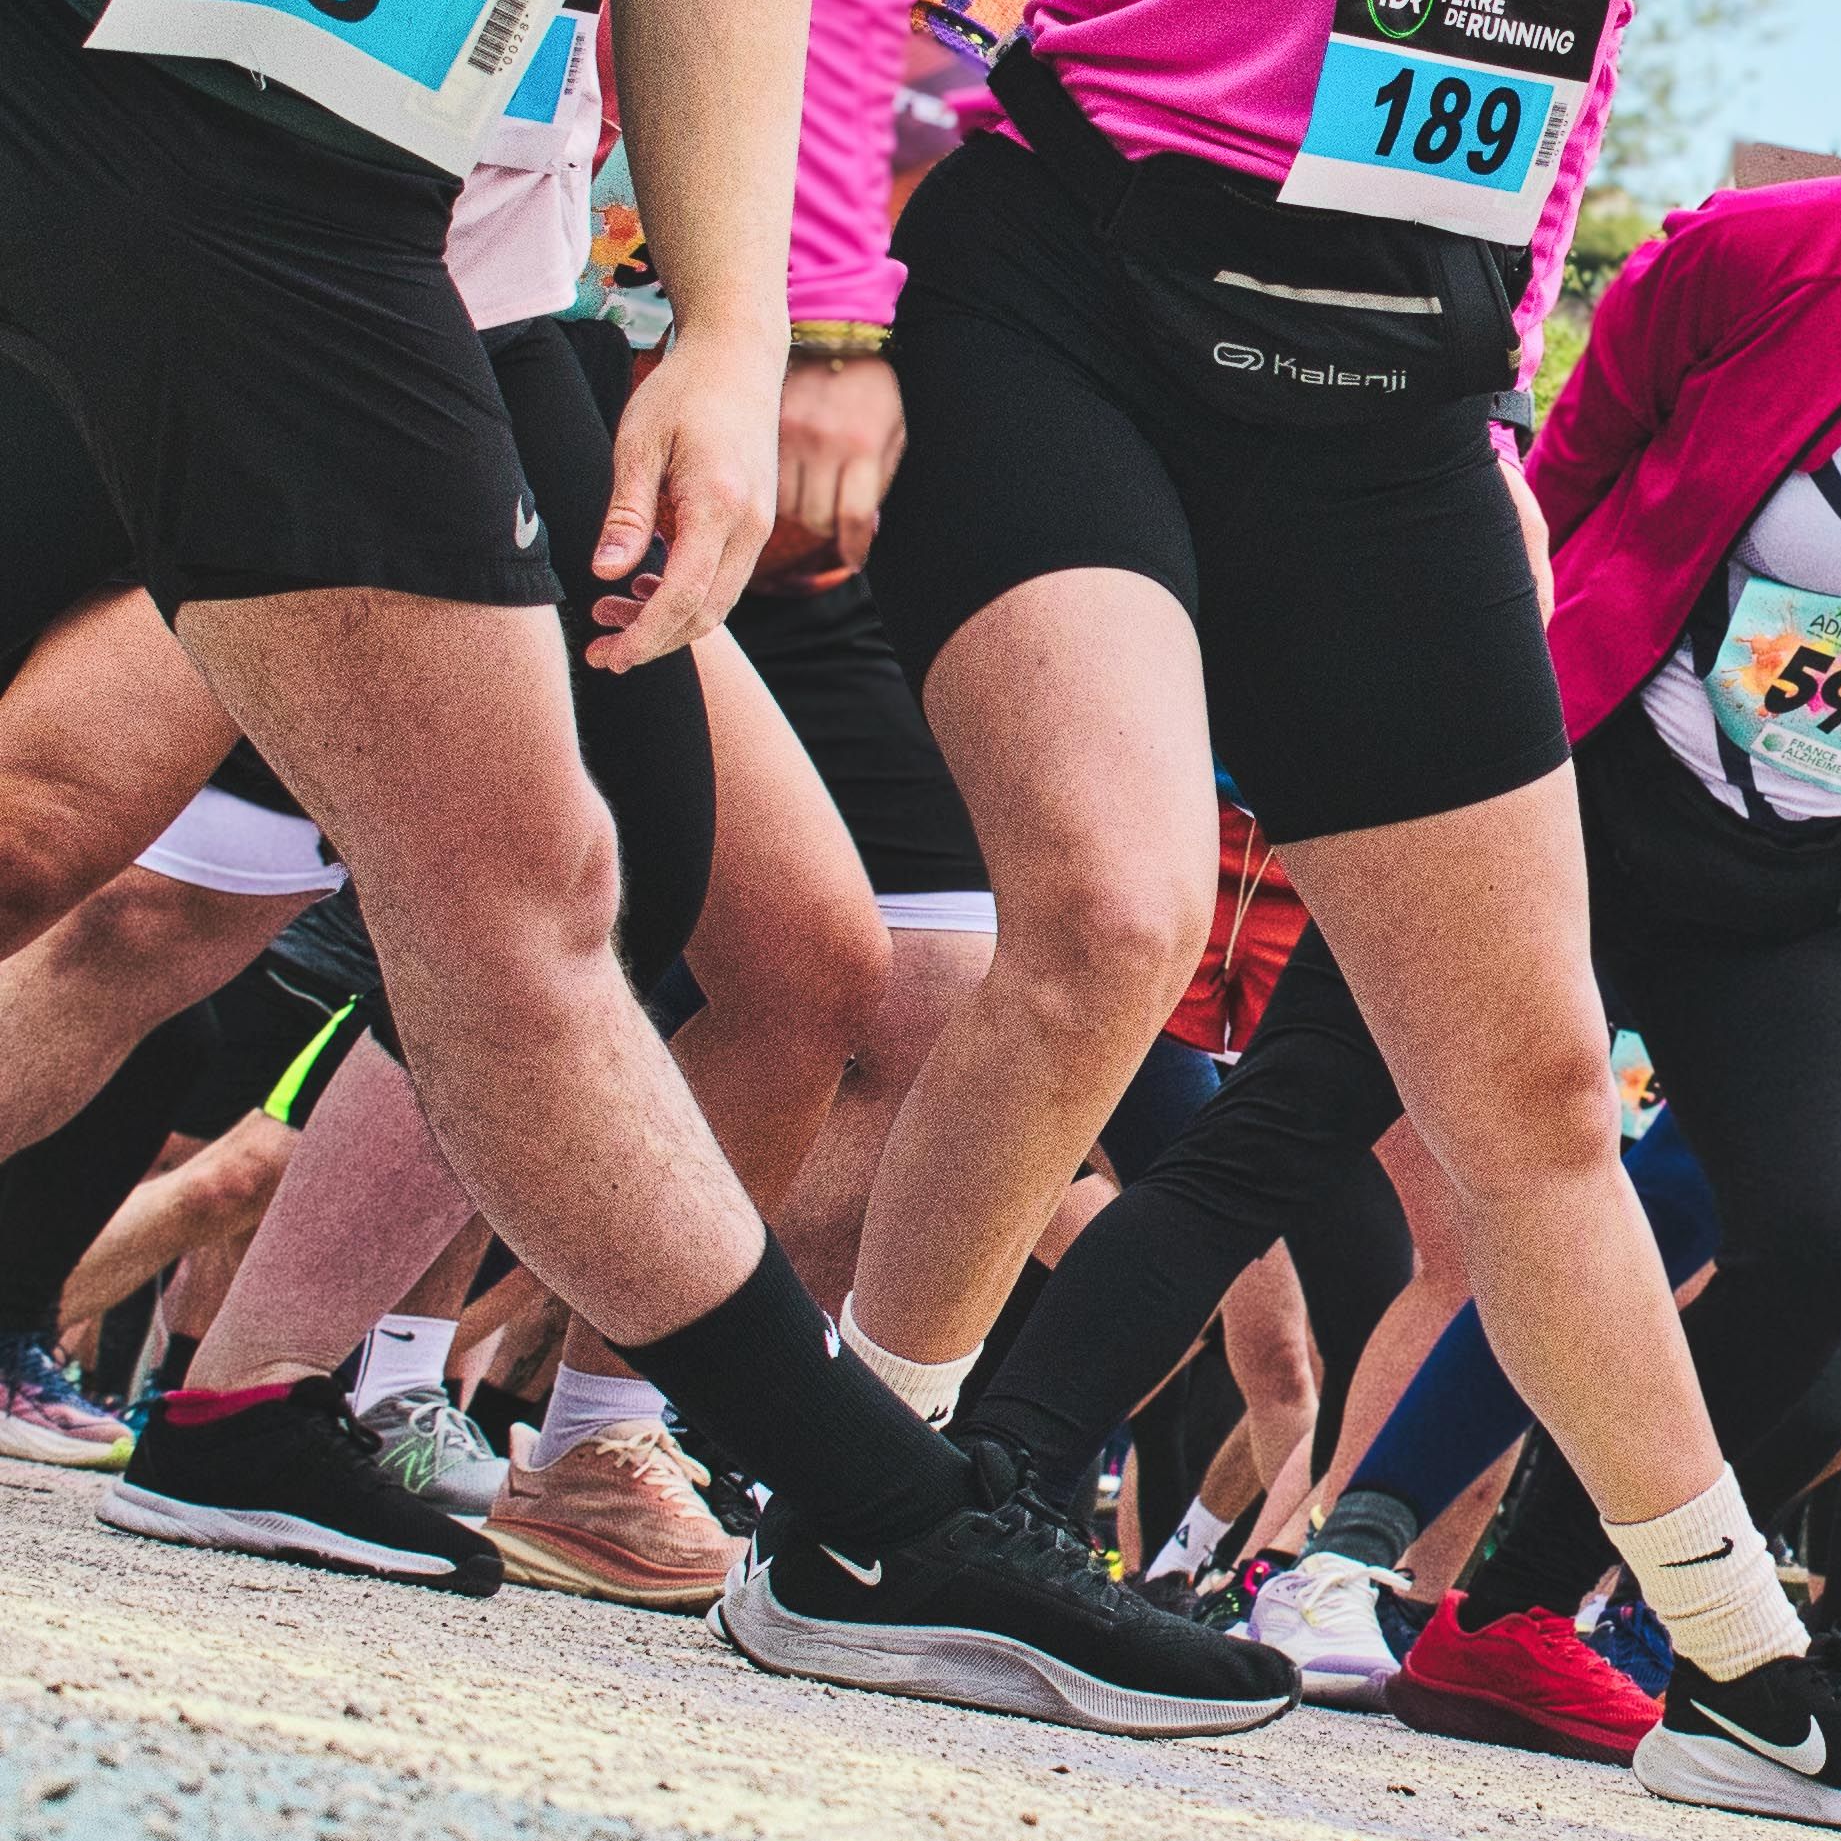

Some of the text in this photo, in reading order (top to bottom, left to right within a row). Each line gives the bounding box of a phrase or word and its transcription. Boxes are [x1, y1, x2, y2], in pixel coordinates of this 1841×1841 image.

[1444, 9, 1575, 55] DE RUNNING
[1374, 68, 1522, 176] 189
[1273, 354, 1408, 394] Kalenji
[1789, 738, 1838, 762] FRANCE
